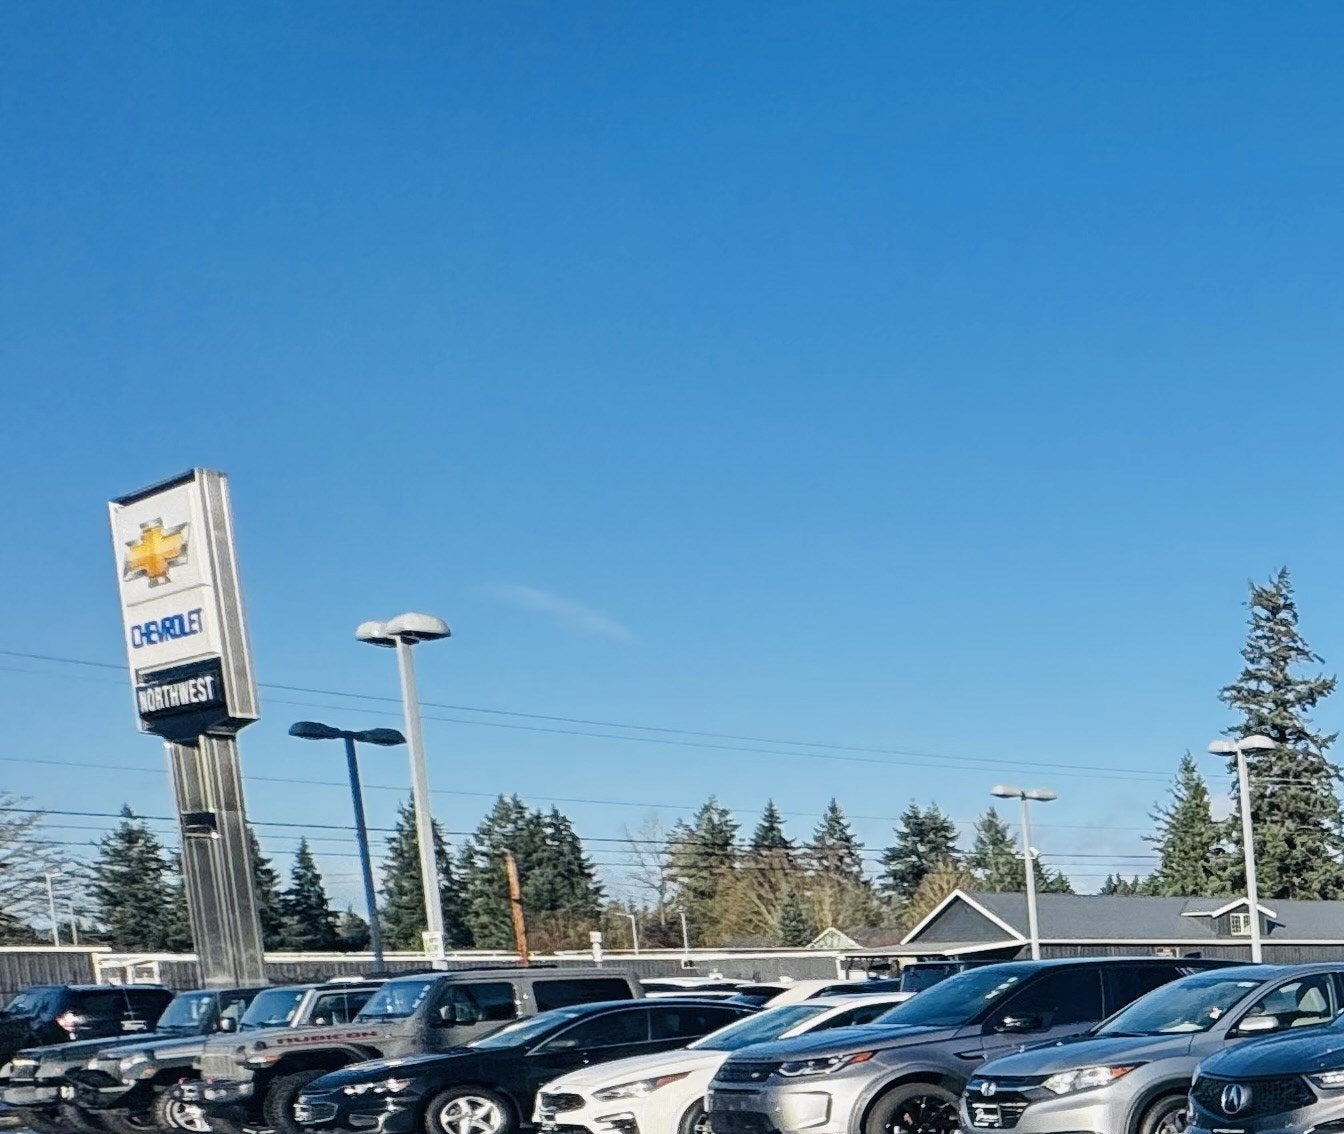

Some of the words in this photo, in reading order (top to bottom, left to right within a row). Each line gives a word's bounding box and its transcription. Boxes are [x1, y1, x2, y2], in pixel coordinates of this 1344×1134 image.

[131, 607, 204, 650] CHEVROLET
[138, 675, 215, 714] NORTHWEST
[276, 1030, 378, 1045] RUBICON
